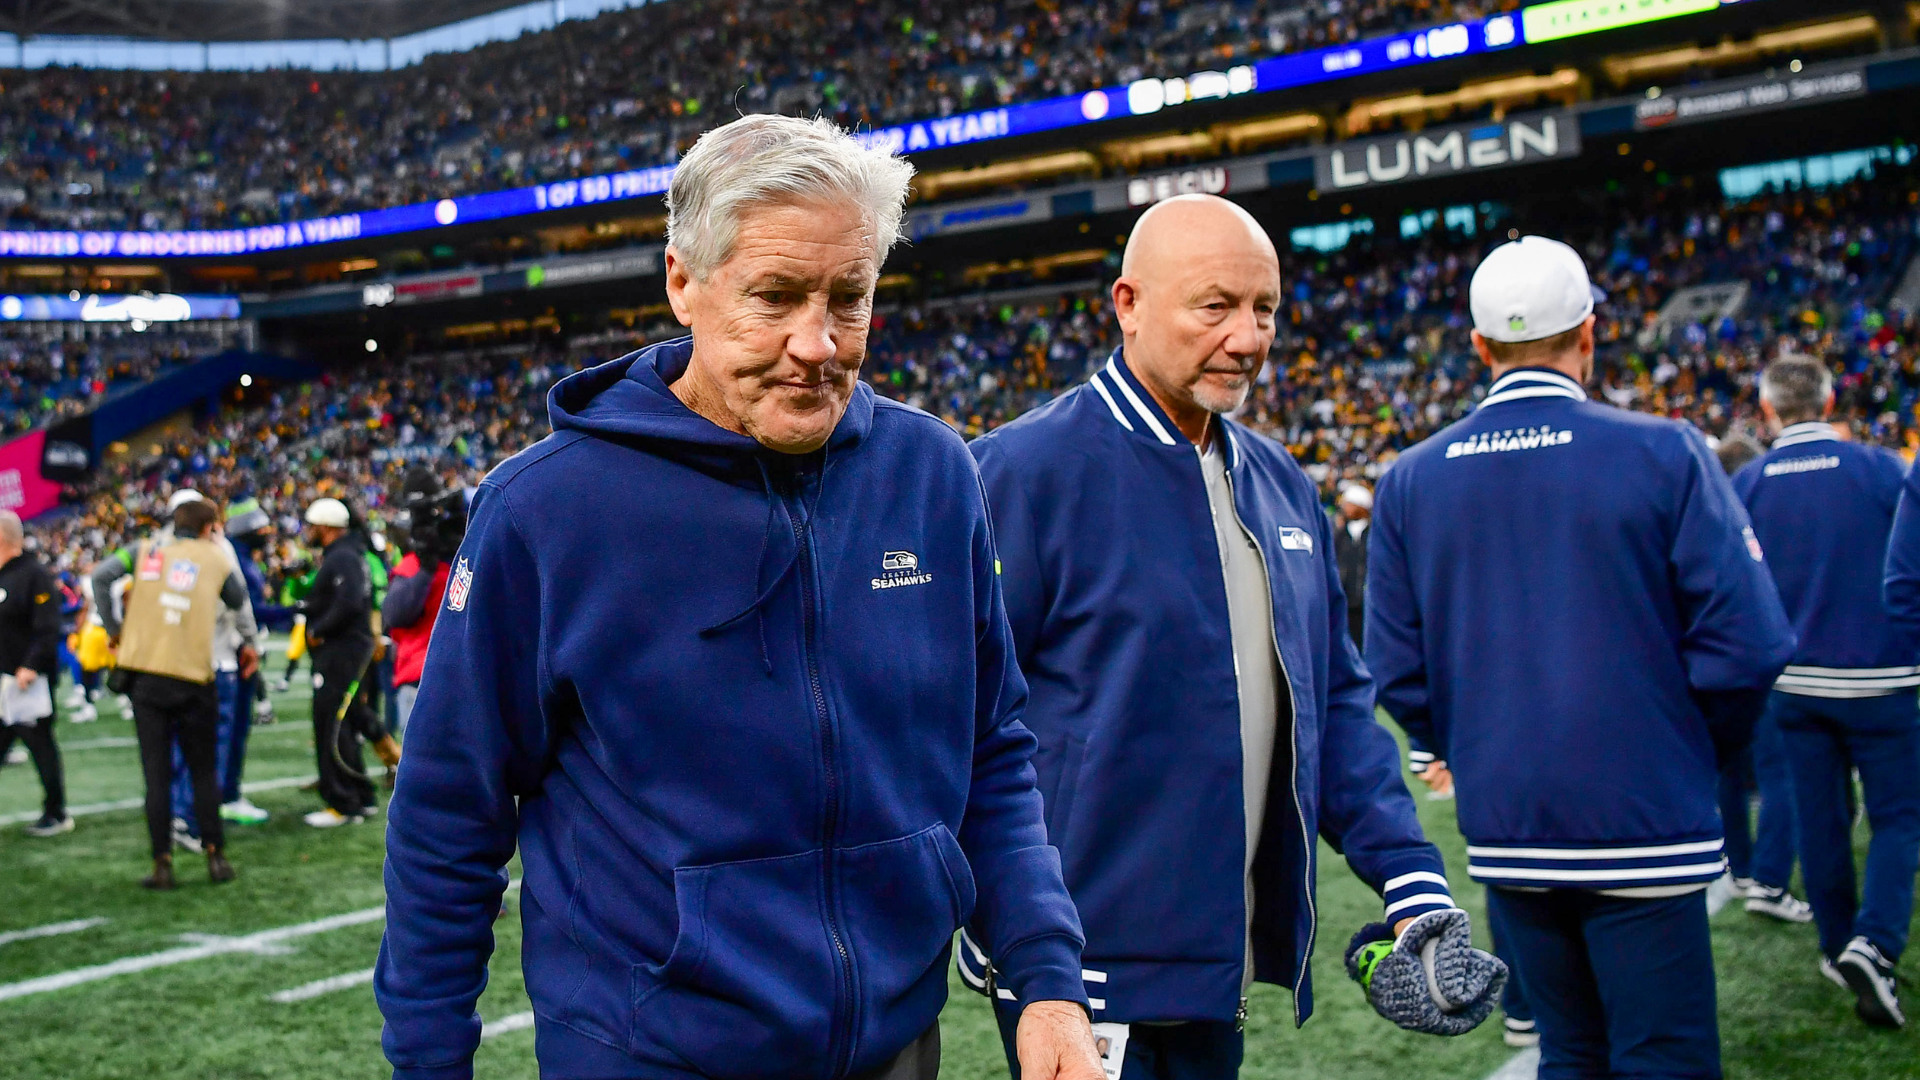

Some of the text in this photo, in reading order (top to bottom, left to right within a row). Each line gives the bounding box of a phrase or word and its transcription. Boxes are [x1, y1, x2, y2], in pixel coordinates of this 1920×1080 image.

[908, 123, 930, 150] A
[931, 108, 1009, 145] YEAR!
[1331, 116, 1559, 188] LUMEN
[548, 181, 578, 207] OF
[1128, 166, 1227, 206] BECU
[0, 213, 361, 256] PRIZES OF GROCERIES FOR A YEAR!
[1445, 430, 1573, 459] SEAHAWKS
[871, 573, 932, 590] SEAHAWKS
[882, 569, 922, 579] SEATTLE
